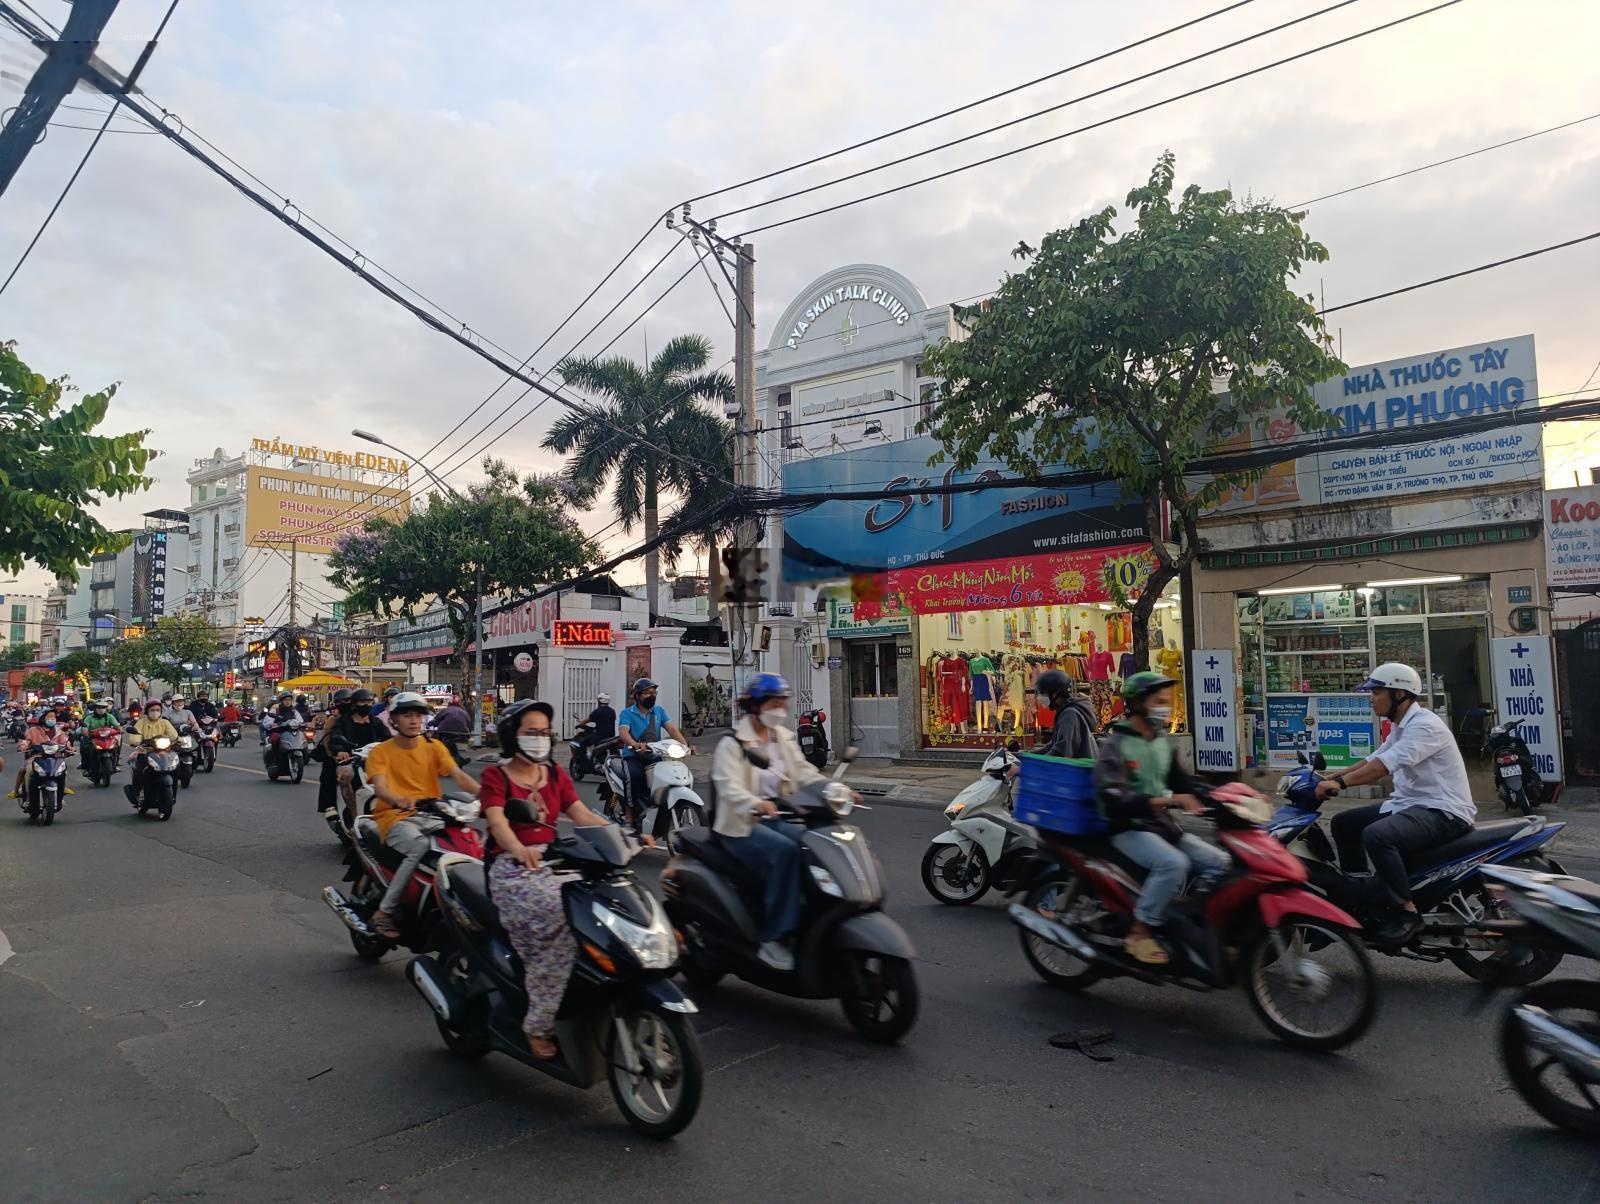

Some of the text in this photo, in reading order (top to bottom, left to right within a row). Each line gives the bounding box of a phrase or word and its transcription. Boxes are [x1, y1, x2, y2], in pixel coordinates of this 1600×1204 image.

[788, 285, 910, 350] PYA SKIN TALK CLINIC
[1343, 347, 1508, 396] NHÀ THUỐC TÂY
[1326, 377, 1525, 438] KIM PHƯƠNG
[253, 436, 294, 457] THẨM
[297, 446, 319, 461] MỸ
[355, 451, 409, 476] EDENA
[1332, 456, 1366, 470] CHUYÊN
[1405, 445, 1436, 461] THUỐC
[1440, 445, 1455, 457] NỘI
[1462, 440, 1492, 453] NGOẠI
[1494, 435, 1522, 448] NHẬP
[259, 475, 291, 493] PHUN
[279, 500, 313, 515] PHUN
[1001, 492, 1069, 516] FASHION
[280, 517, 314, 531] PHUN
[1033, 526, 1143, 548] www.sifafashion.com
[916, 571, 954, 592] Chúc
[1009, 582, 1022, 604] 6
[1204, 674, 1222, 694] NHÀ
[1509, 664, 1535, 687] NHÀ
[1200, 697, 1228, 718] THUỐC
[1506, 690, 1544, 716] THUỐC
[1205, 726, 1224, 742] KIM
[1514, 725, 1541, 744] KIM
[1198, 748, 1233, 767] PHƯƠNG
